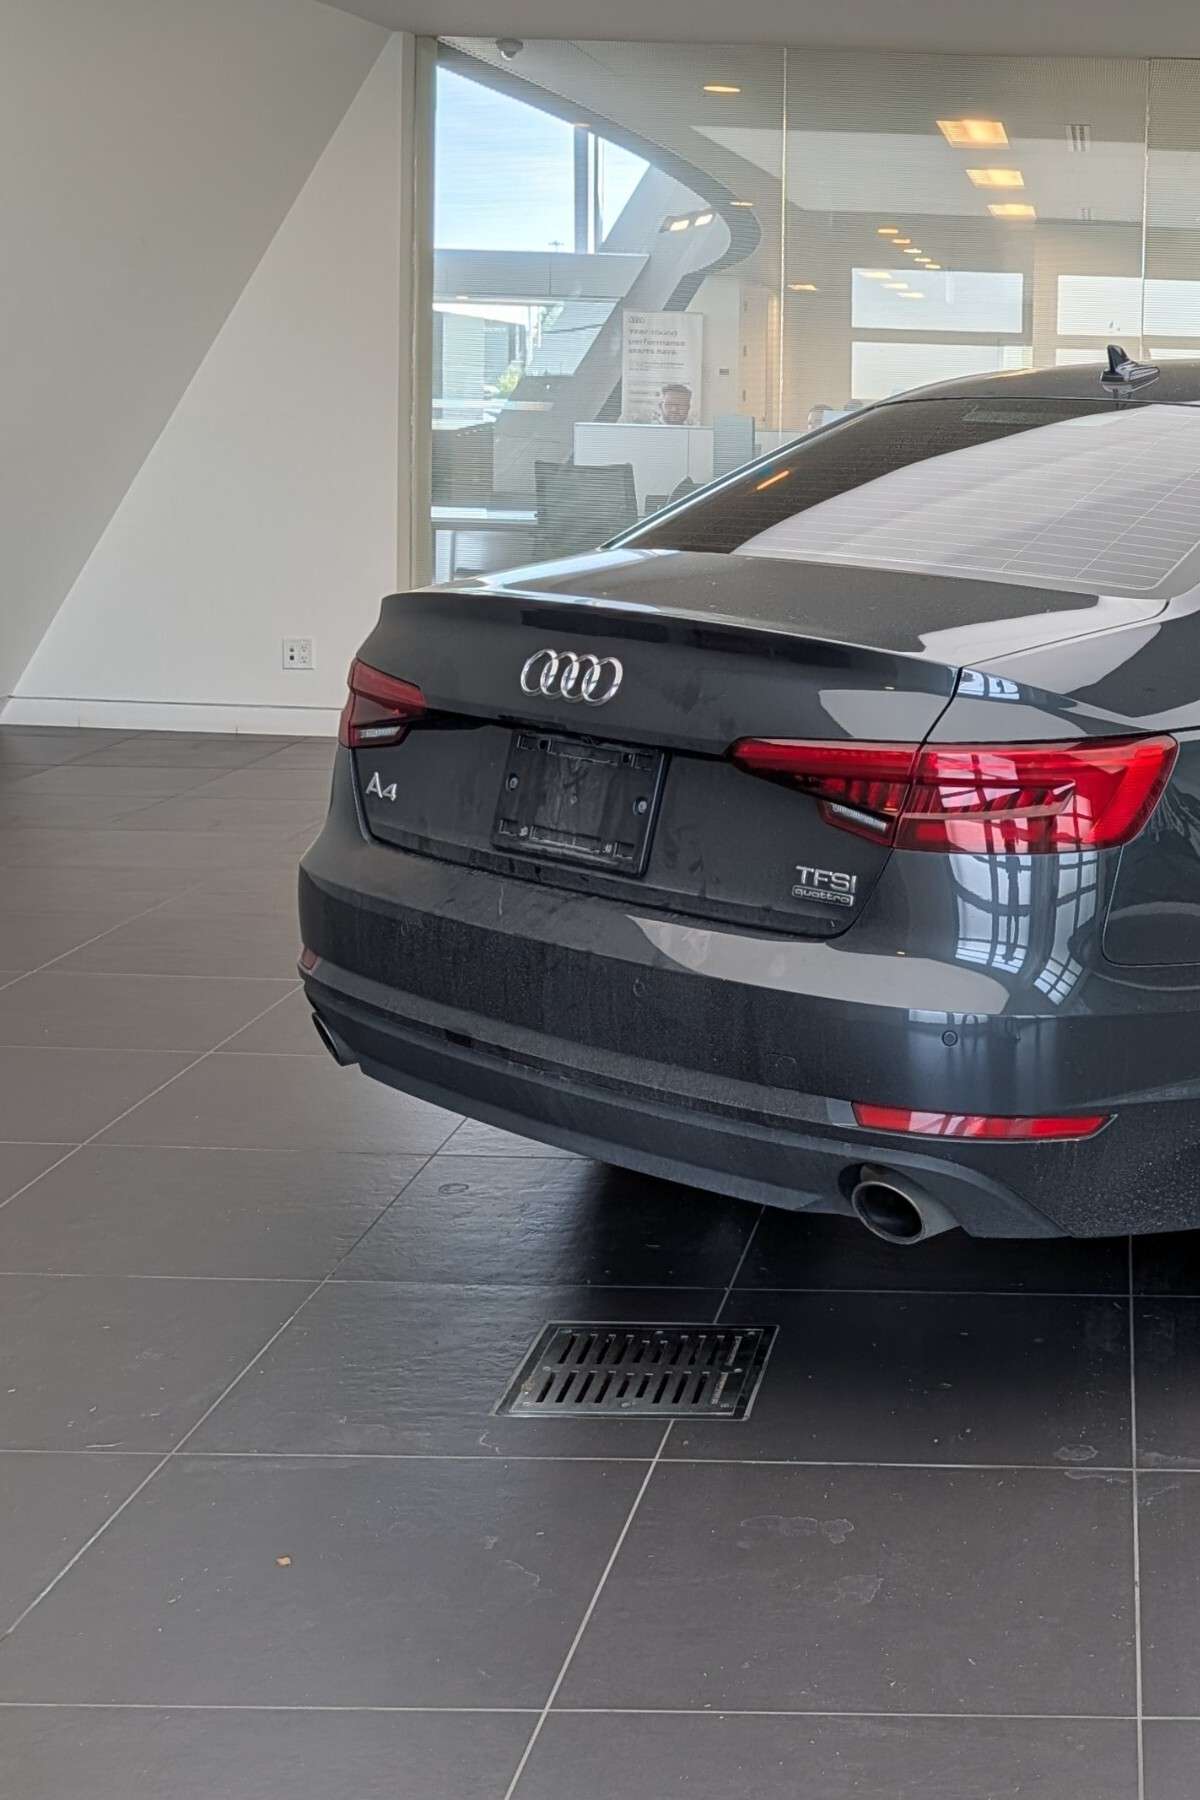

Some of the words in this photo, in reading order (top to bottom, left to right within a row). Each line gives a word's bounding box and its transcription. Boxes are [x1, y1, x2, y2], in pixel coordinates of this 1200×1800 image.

[365, 771, 397, 801] A4
[795, 865, 857, 893] TFSI
[794, 887, 850, 904] quattro
